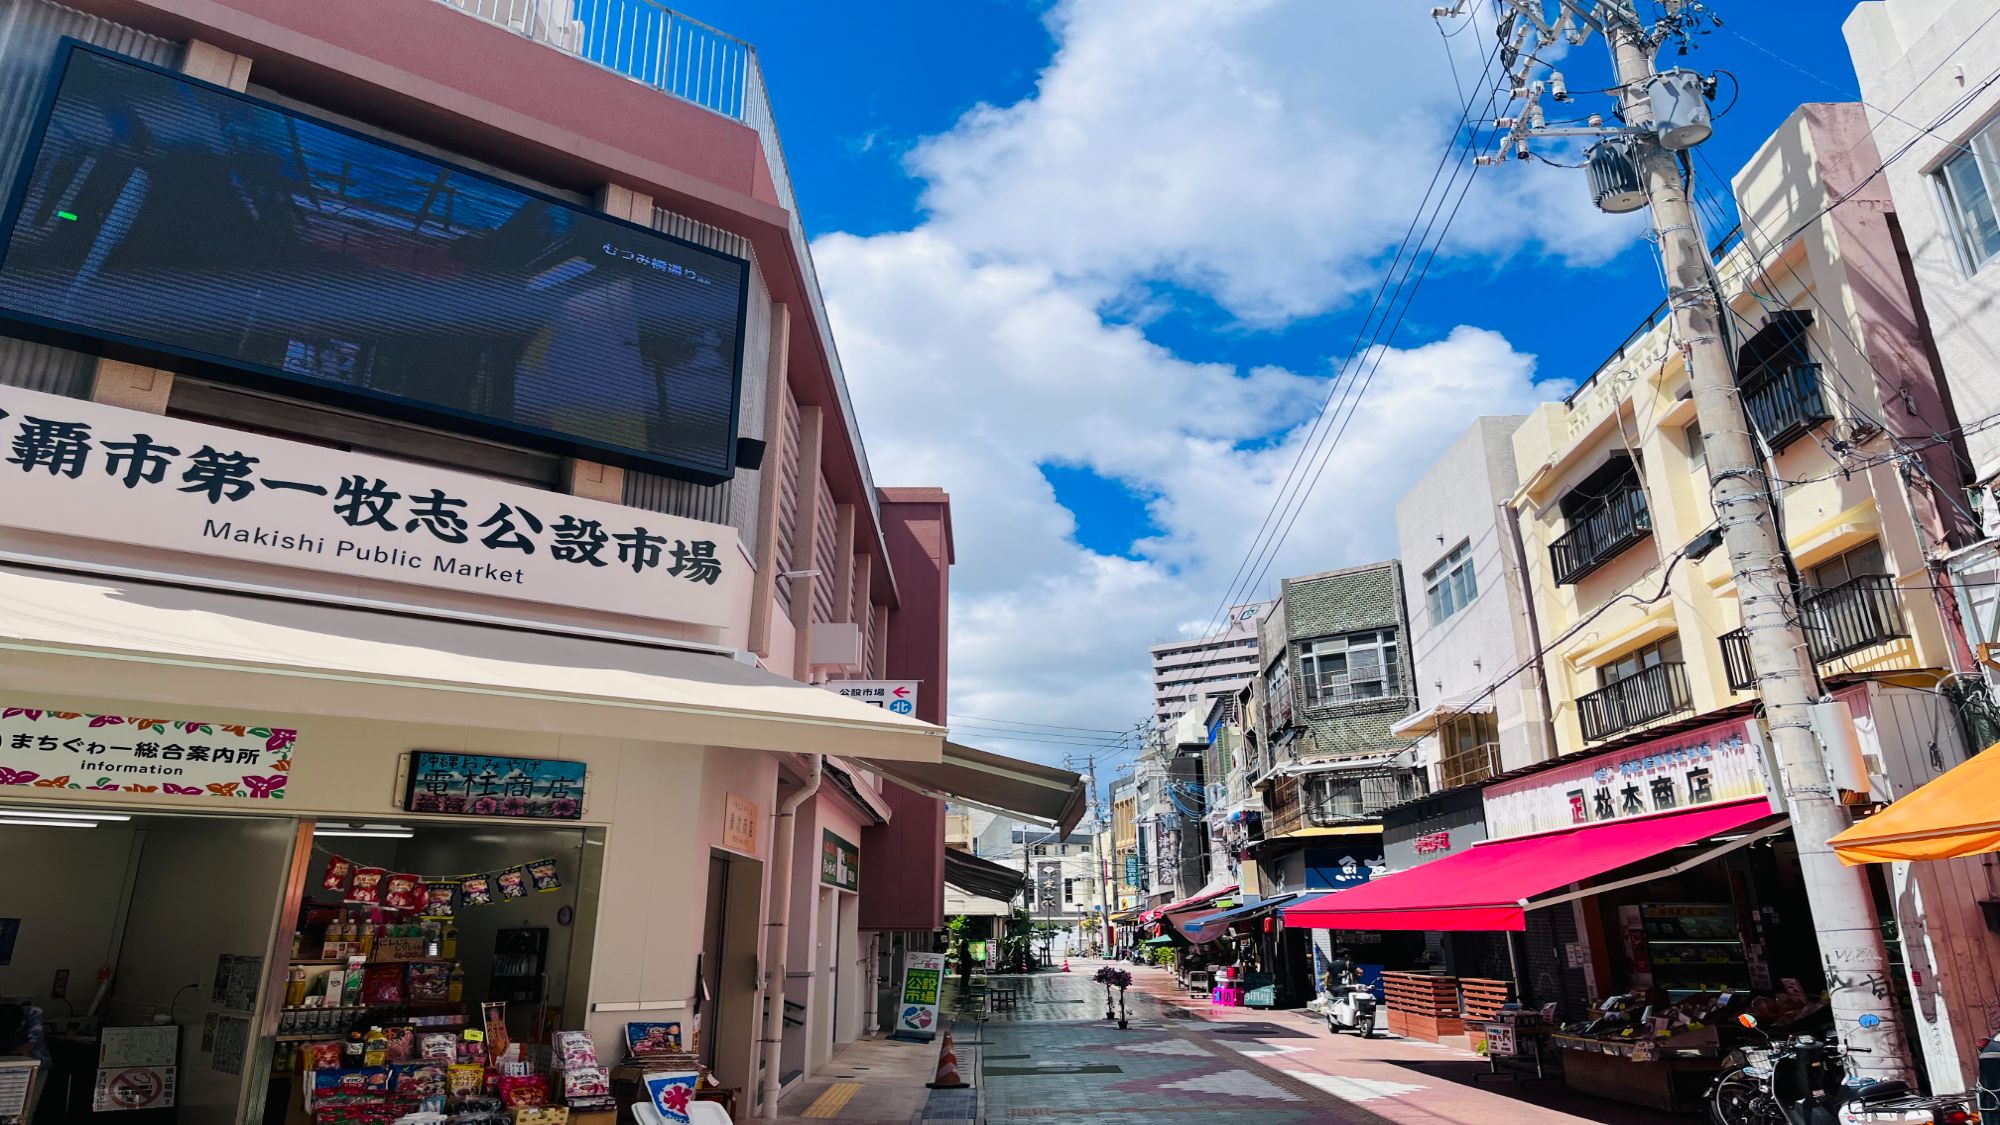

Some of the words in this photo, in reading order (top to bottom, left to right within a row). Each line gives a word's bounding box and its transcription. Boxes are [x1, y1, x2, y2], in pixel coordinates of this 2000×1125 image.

[0, 407, 722, 585] 覇市第一牧志公設市場
[203, 519, 324, 554] Makishi
[337, 540, 422, 569] Public
[434, 555, 525, 584] Market
[839, 688, 885, 697] 公設市場
[80, 760, 184, 776] information
[421, 753, 543, 773] 沖縄おみやげ
[423, 768, 577, 799] 電柱商店
[1594, 766, 1713, 821] 松本商店
[907, 977, 938, 990] 公設
[905, 990, 936, 1004] 市場
